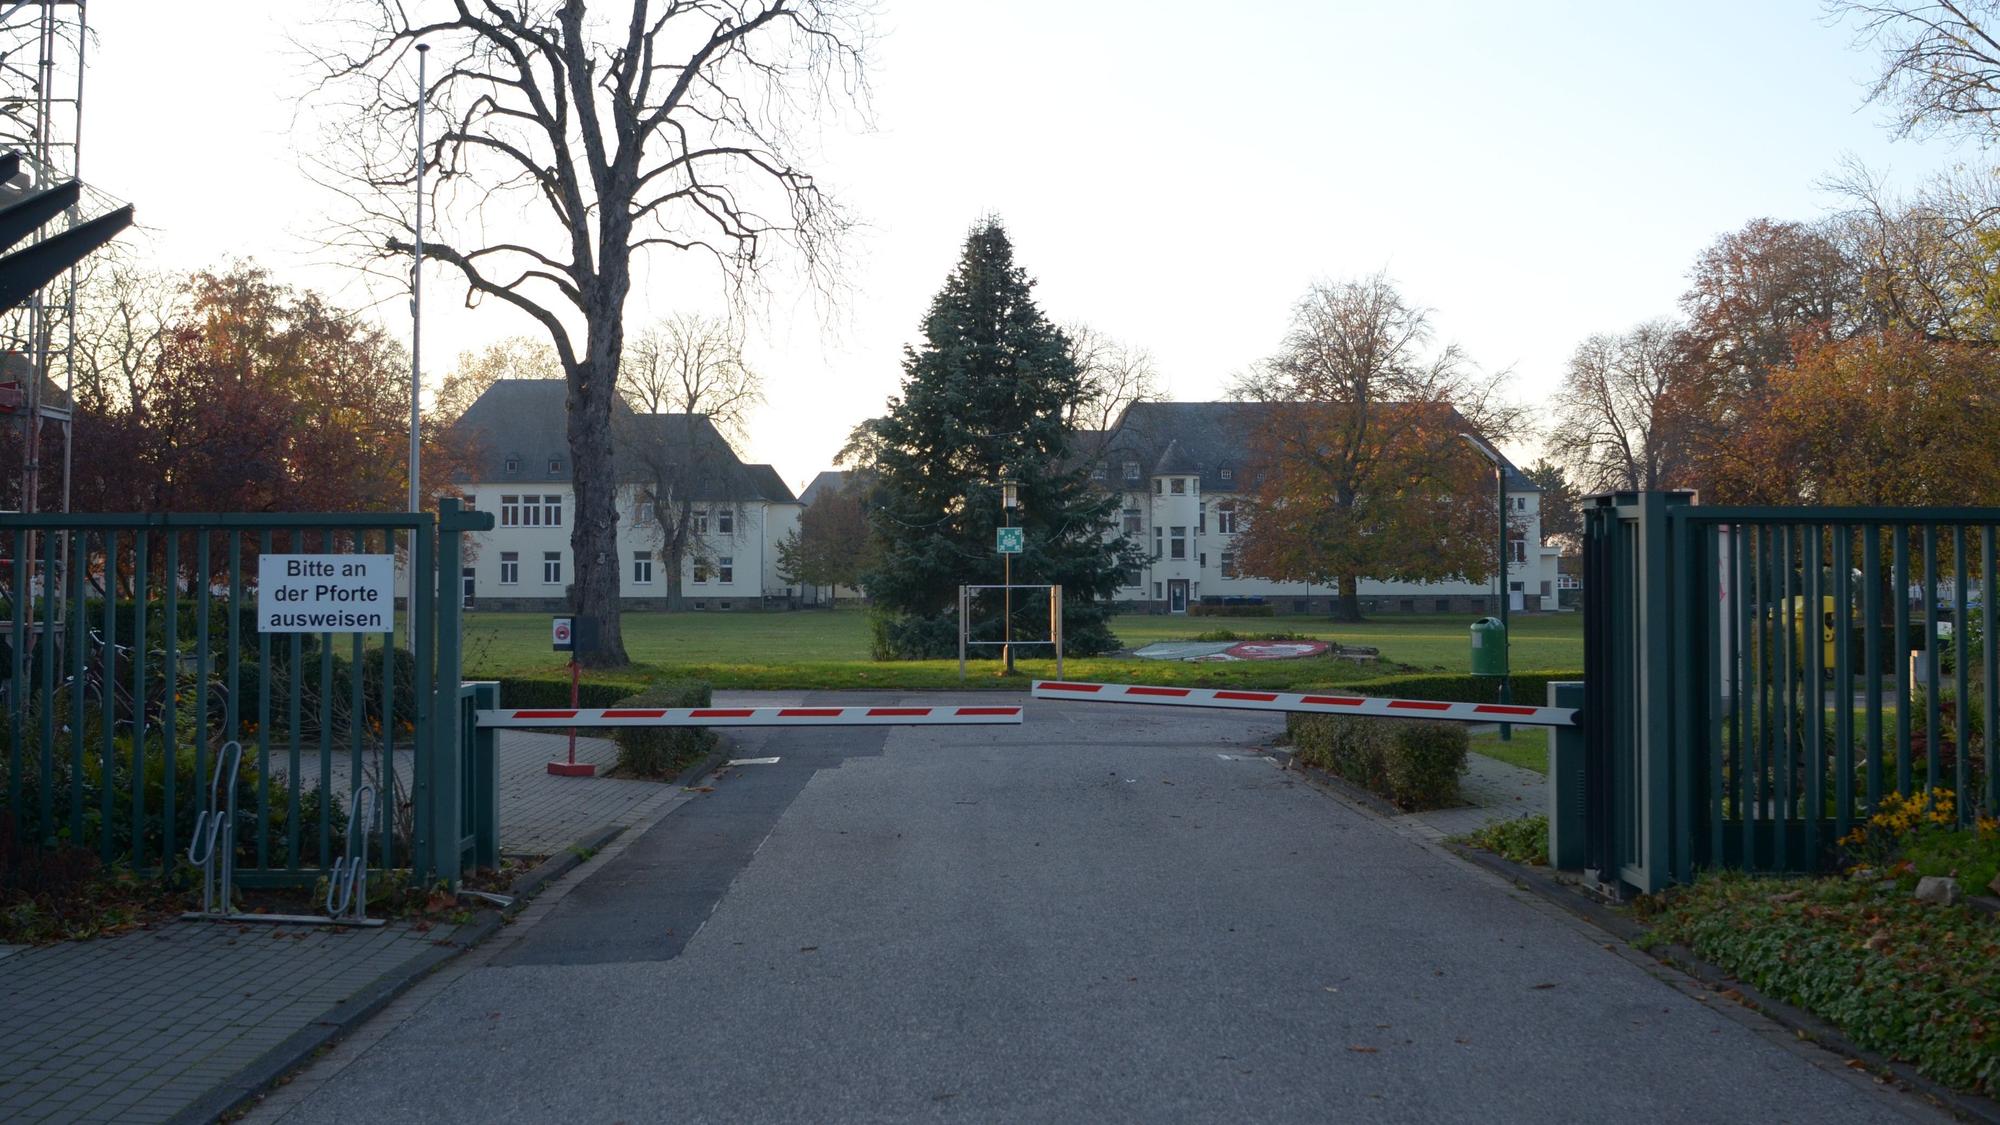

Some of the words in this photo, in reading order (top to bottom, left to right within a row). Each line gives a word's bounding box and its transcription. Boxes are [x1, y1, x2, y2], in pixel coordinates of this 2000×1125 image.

[286, 559, 334, 577] Bitte
[341, 563, 366, 577] an
[274, 584, 309, 602] der
[315, 584, 378, 602] Pforte
[270, 609, 381, 627] ausweisen
